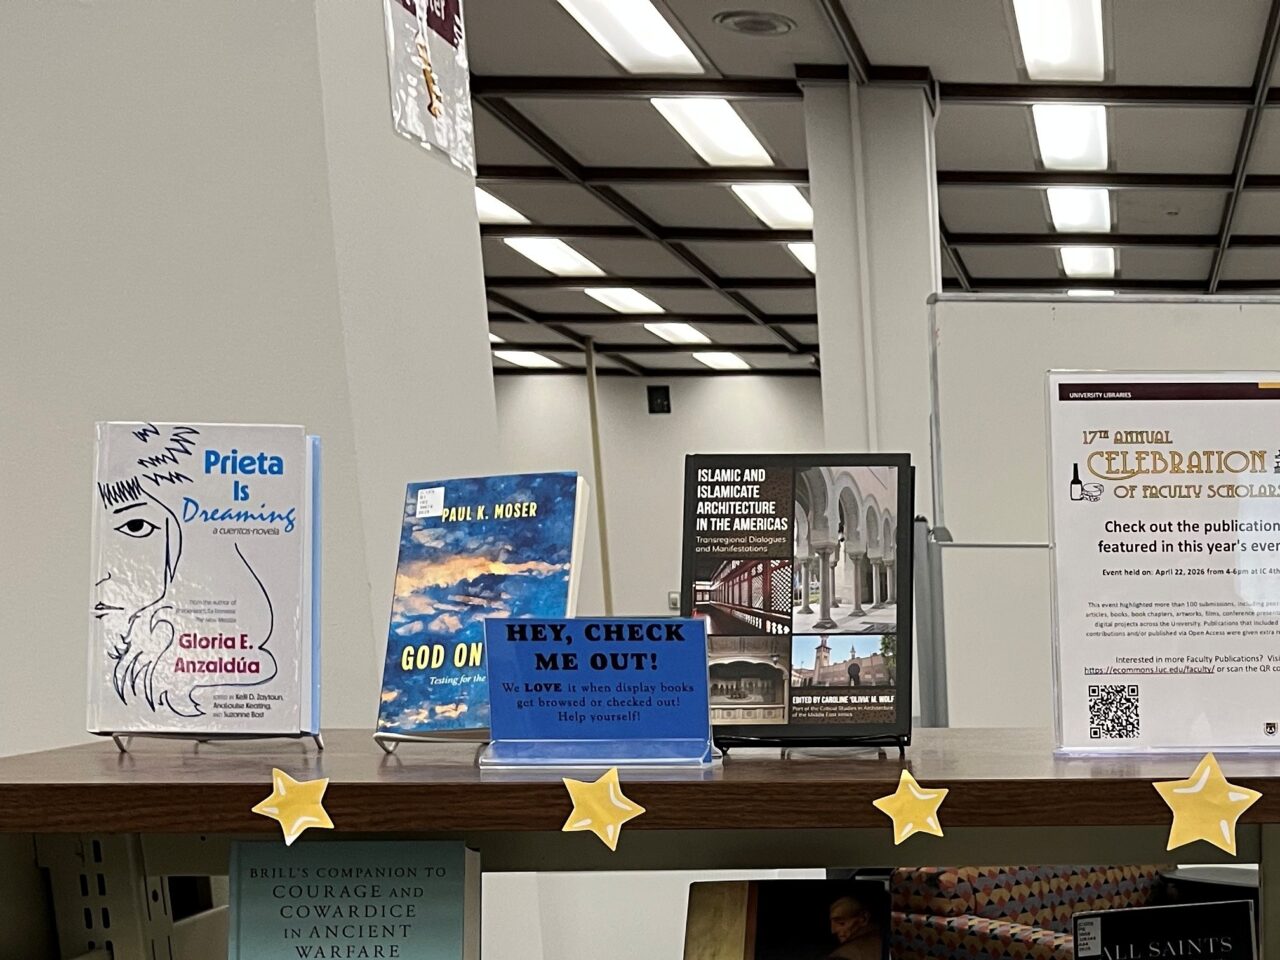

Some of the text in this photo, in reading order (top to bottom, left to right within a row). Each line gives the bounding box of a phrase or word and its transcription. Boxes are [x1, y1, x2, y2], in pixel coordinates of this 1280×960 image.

[1069, 391, 1132, 399] UNIVERSITY LIBRARIES
[1114, 430, 1173, 445] ANNUAL
[204, 449, 284, 475] Prieta
[1087, 450, 1267, 480] CELEBRATION
[698, 468, 766, 483] ISLAMIC AND
[233, 480, 250, 501] Is
[697, 485, 760, 499] ISLAMICATE
[1114, 485, 1136, 499] OF
[1143, 485, 1202, 499] FACULTY
[182, 497, 297, 533] Dreaming
[441, 501, 538, 523] PAUL K. MOSER
[697, 501, 776, 516] ARCHITECTURE
[696, 517, 789, 532] IN THE AMERICAS
[1105, 520, 1146, 534] Check
[1150, 522, 1173, 533] out
[1177, 520, 1200, 533] the
[1098, 540, 1158, 554] featured
[1161, 540, 1174, 553] in
[1178, 540, 1203, 553] this
[1206, 540, 1248, 556] year's
[1155, 568, 1173, 577] April
[178, 633, 254, 650] Gloria E.
[506, 622, 686, 646] HEY, CHECK
[401, 642, 484, 671] GOD ON
[535, 652, 659, 671] ME OUT!
[173, 656, 260, 675] Anzaldúa
[523, 682, 563, 693] LOVE
[250, 866, 446, 879] BRILL'S COMPANION TO
[272, 885, 424, 899] COURAGE AND
[280, 904, 417, 919] COWARDICE
[284, 924, 412, 939] IN ANCIENT
[295, 945, 401, 959] WARFARE
[1149, 936, 1233, 958] SAINTS
